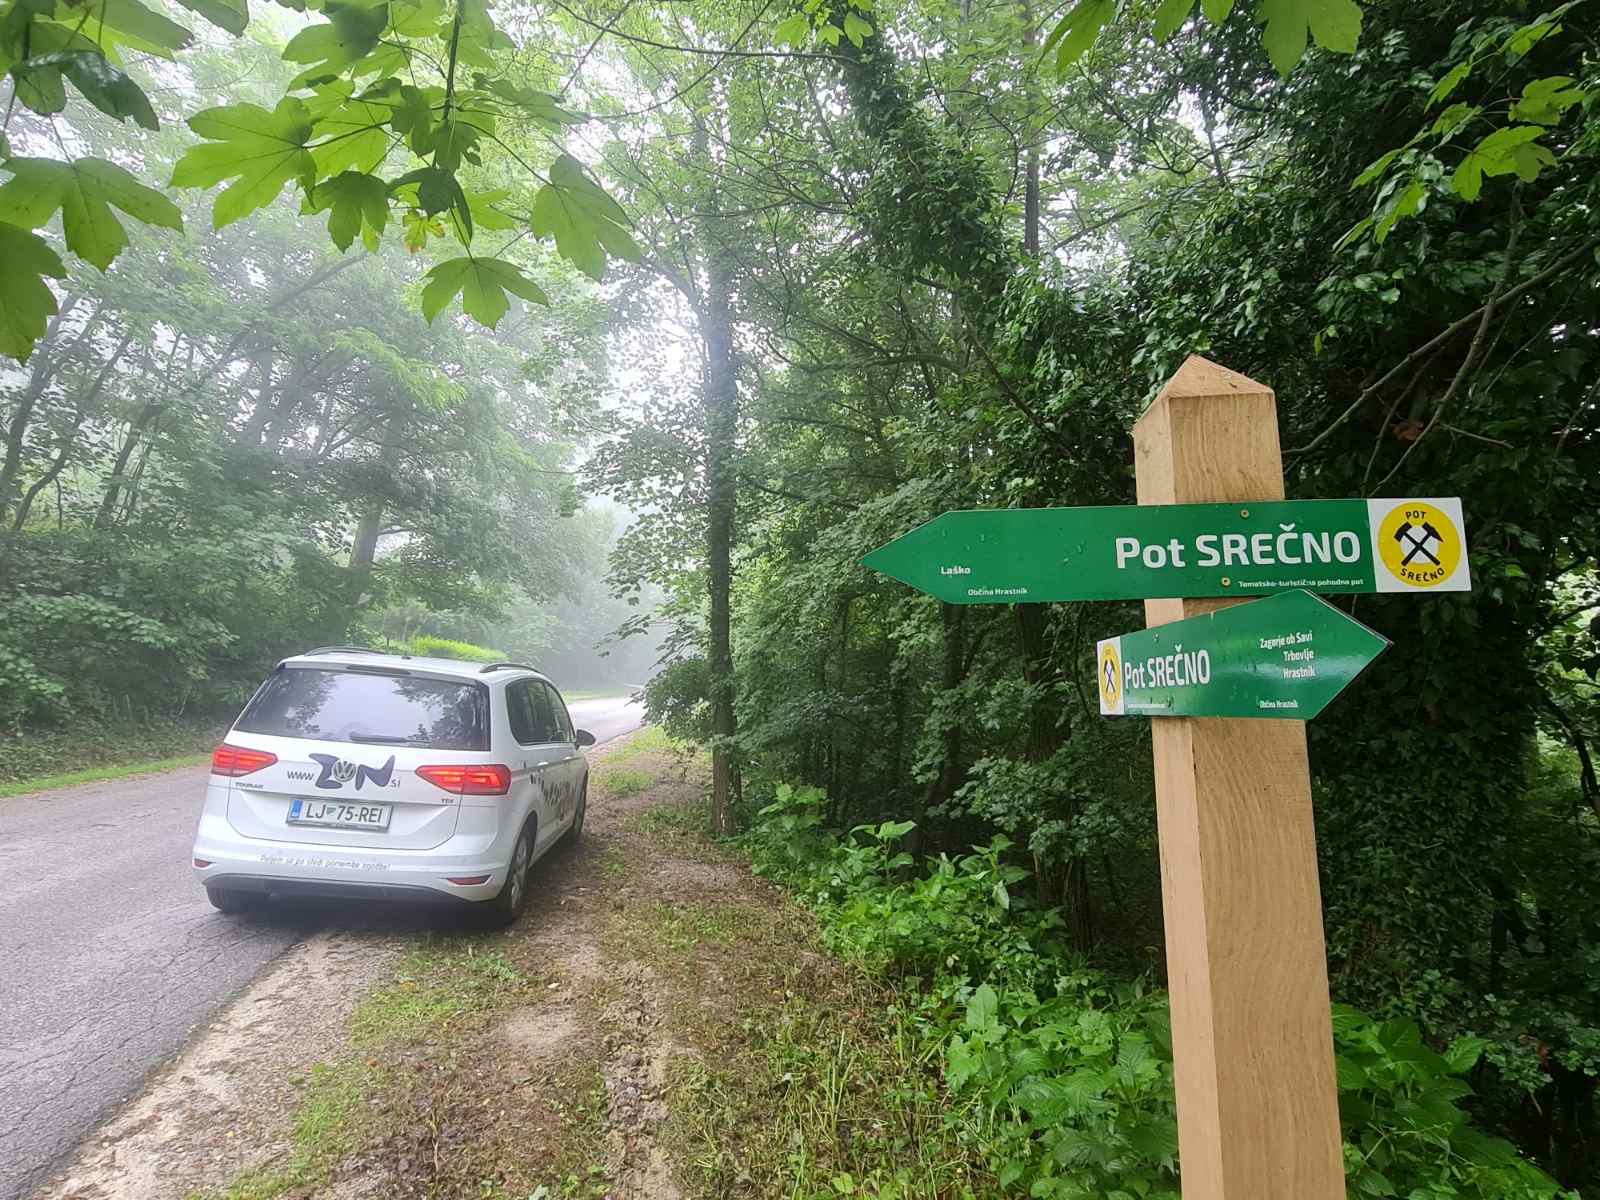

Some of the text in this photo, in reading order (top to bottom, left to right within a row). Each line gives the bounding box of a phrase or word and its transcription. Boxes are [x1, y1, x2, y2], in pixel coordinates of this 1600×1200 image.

[1405, 510, 1426, 519] POT
[1115, 523, 1360, 569] Pot SREČNO
[940, 566, 971, 575] Laško
[1400, 567, 1445, 582] SREČNO
[1351, 578, 1364, 586] pot
[967, 586, 1028, 596] Občina Hrastnik
[1260, 630, 1312, 649] Zagorje ob Savi
[1283, 648, 1314, 661] Trbovlje
[1124, 643, 1210, 689] Pot SREČNO
[1283, 666, 1315, 678] Hrastnik
[306, 803, 327, 819] LJ
